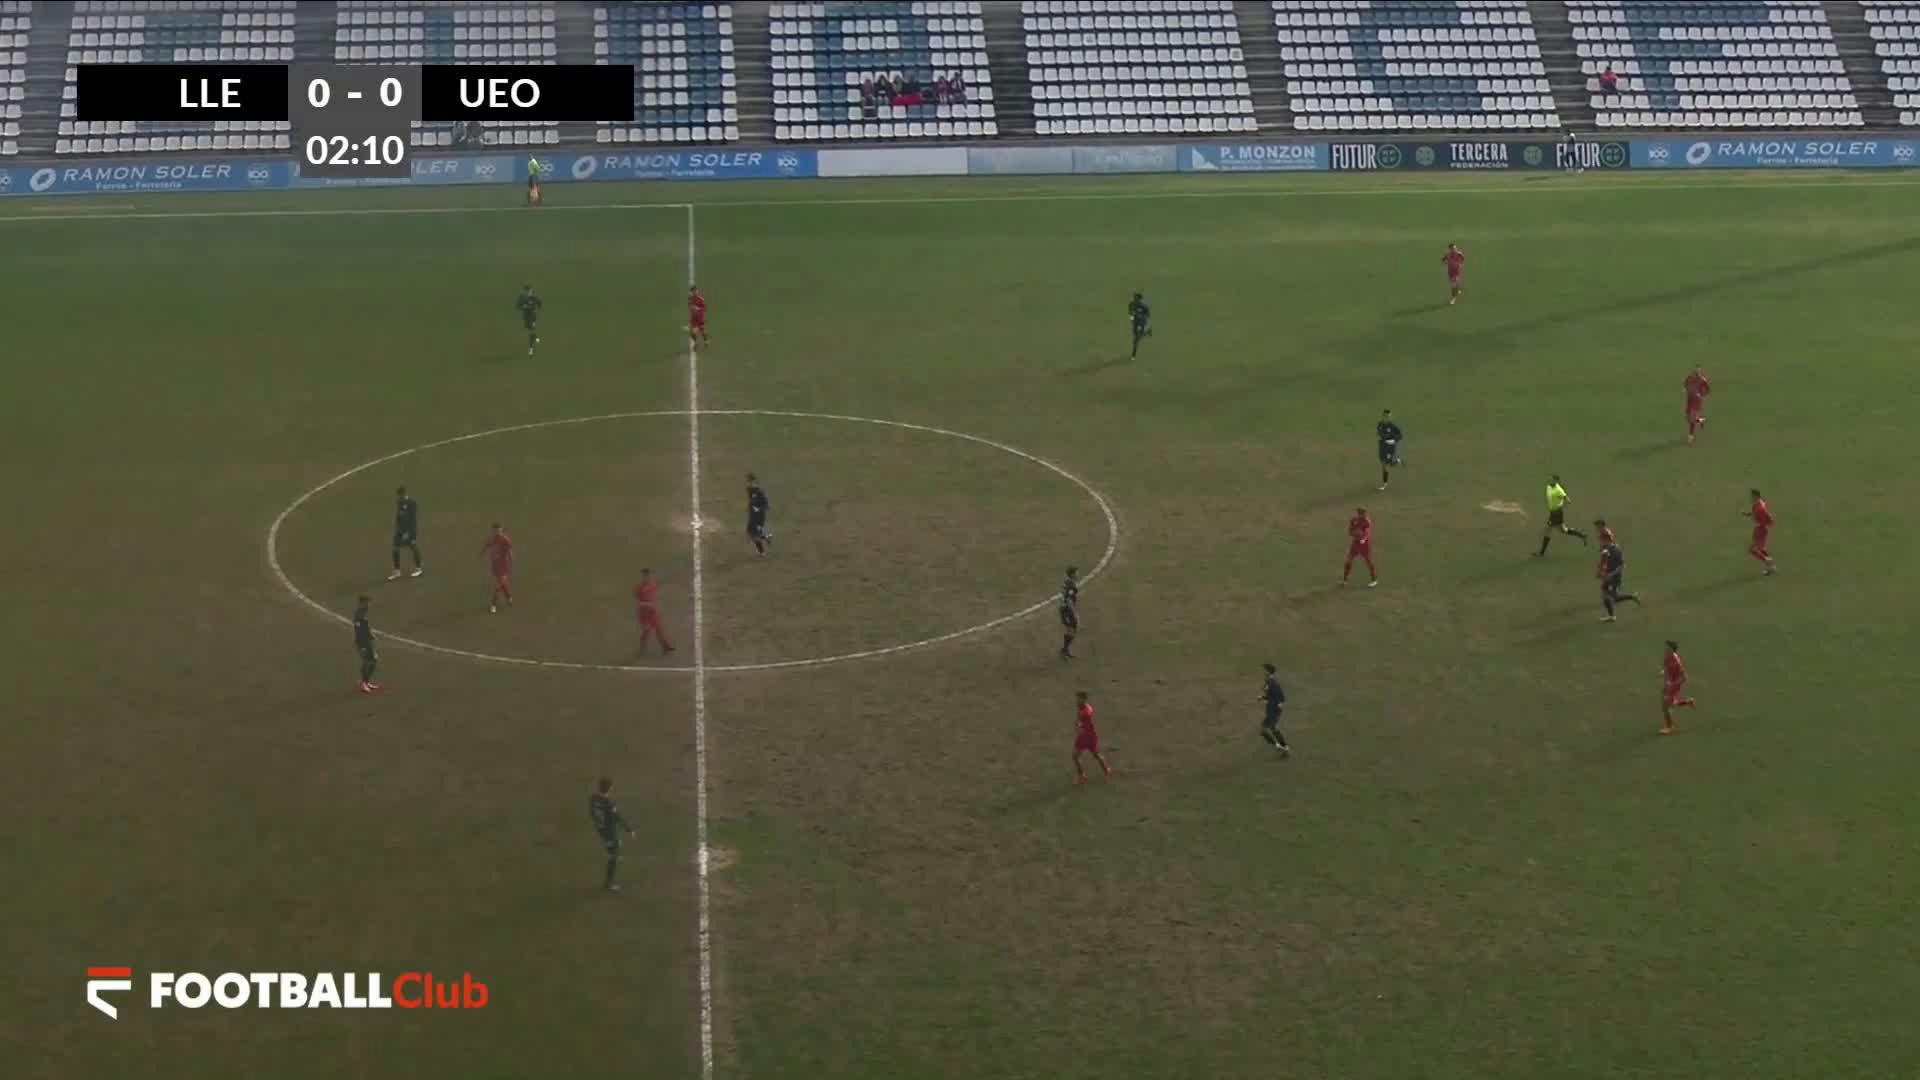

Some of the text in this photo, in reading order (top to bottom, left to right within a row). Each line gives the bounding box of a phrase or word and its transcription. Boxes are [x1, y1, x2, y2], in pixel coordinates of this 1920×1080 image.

[1220, 145, 1316, 159] P. MONZON
[1332, 144, 1378, 169] FUTUR
[1450, 143, 1508, 161] TERCERA
[1718, 142, 1878, 155] RAMON SOLER
[604, 153, 762, 169] RAMON SOLER
[63, 165, 232, 182] RAMON SOLER
